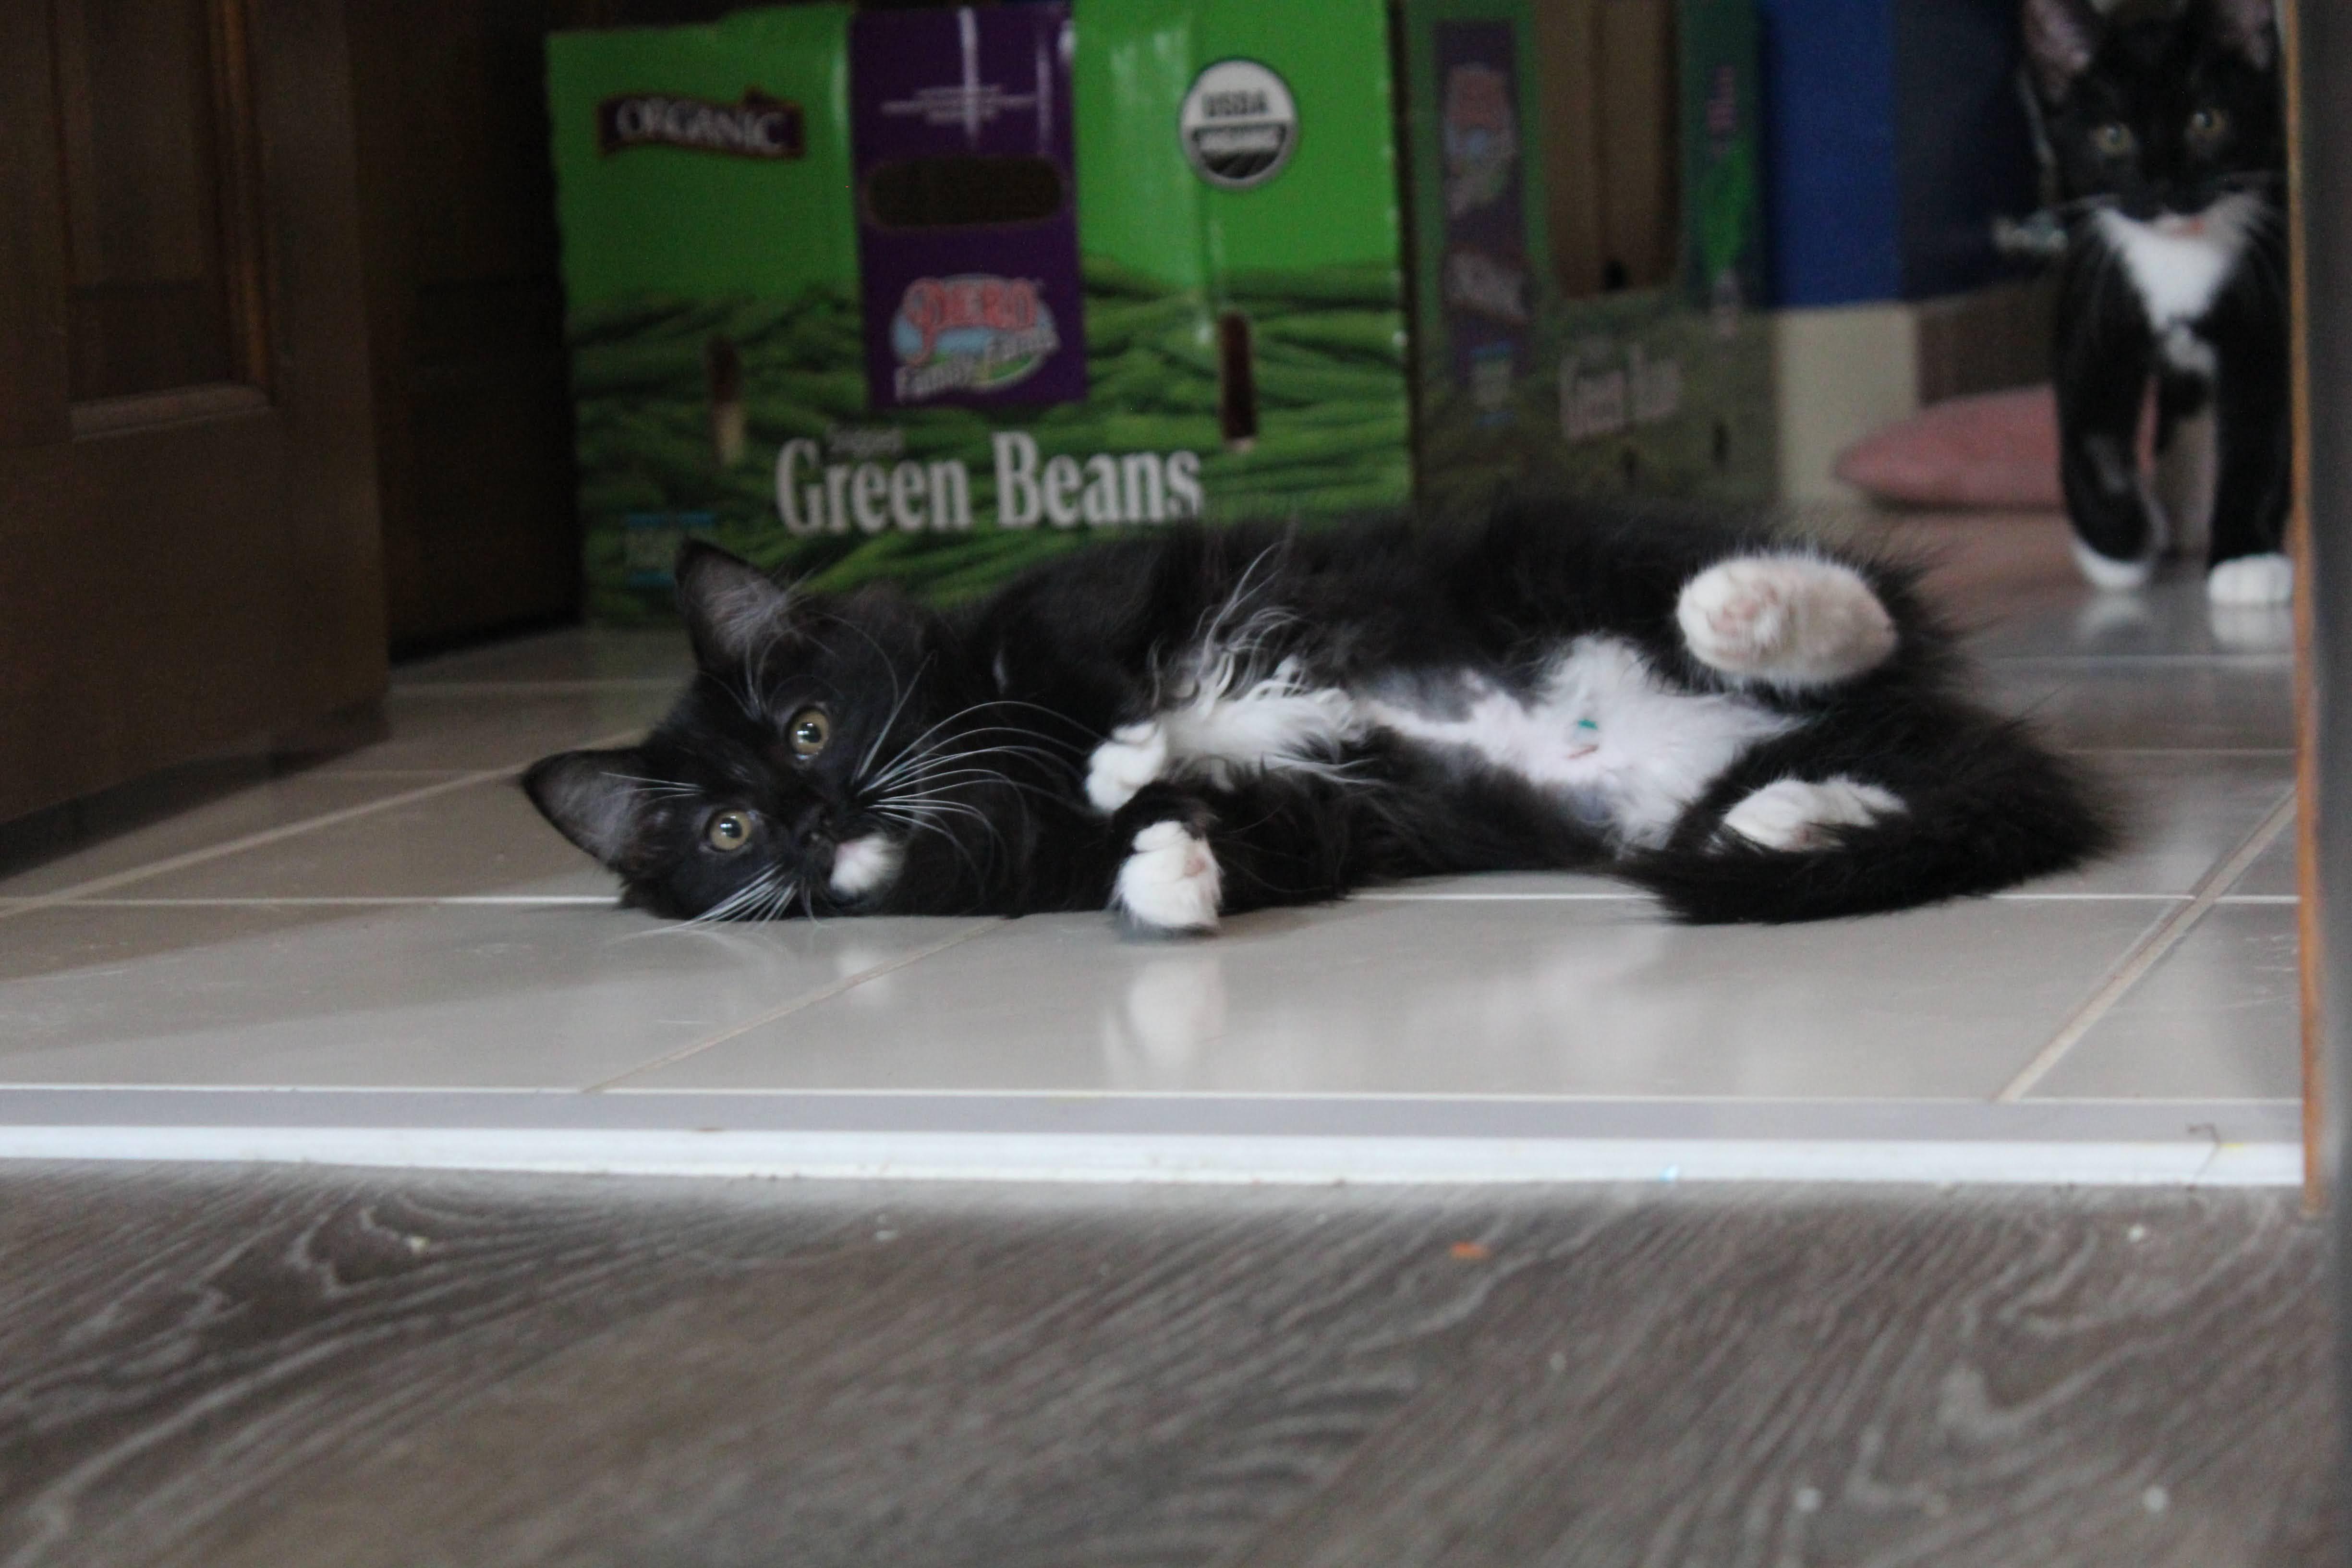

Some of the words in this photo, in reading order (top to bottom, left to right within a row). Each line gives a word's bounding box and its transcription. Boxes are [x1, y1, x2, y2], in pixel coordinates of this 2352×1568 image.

[615, 98, 787, 156] ORGANIC
[775, 437, 972, 537] Green
[992, 430, 1204, 528] Beans
